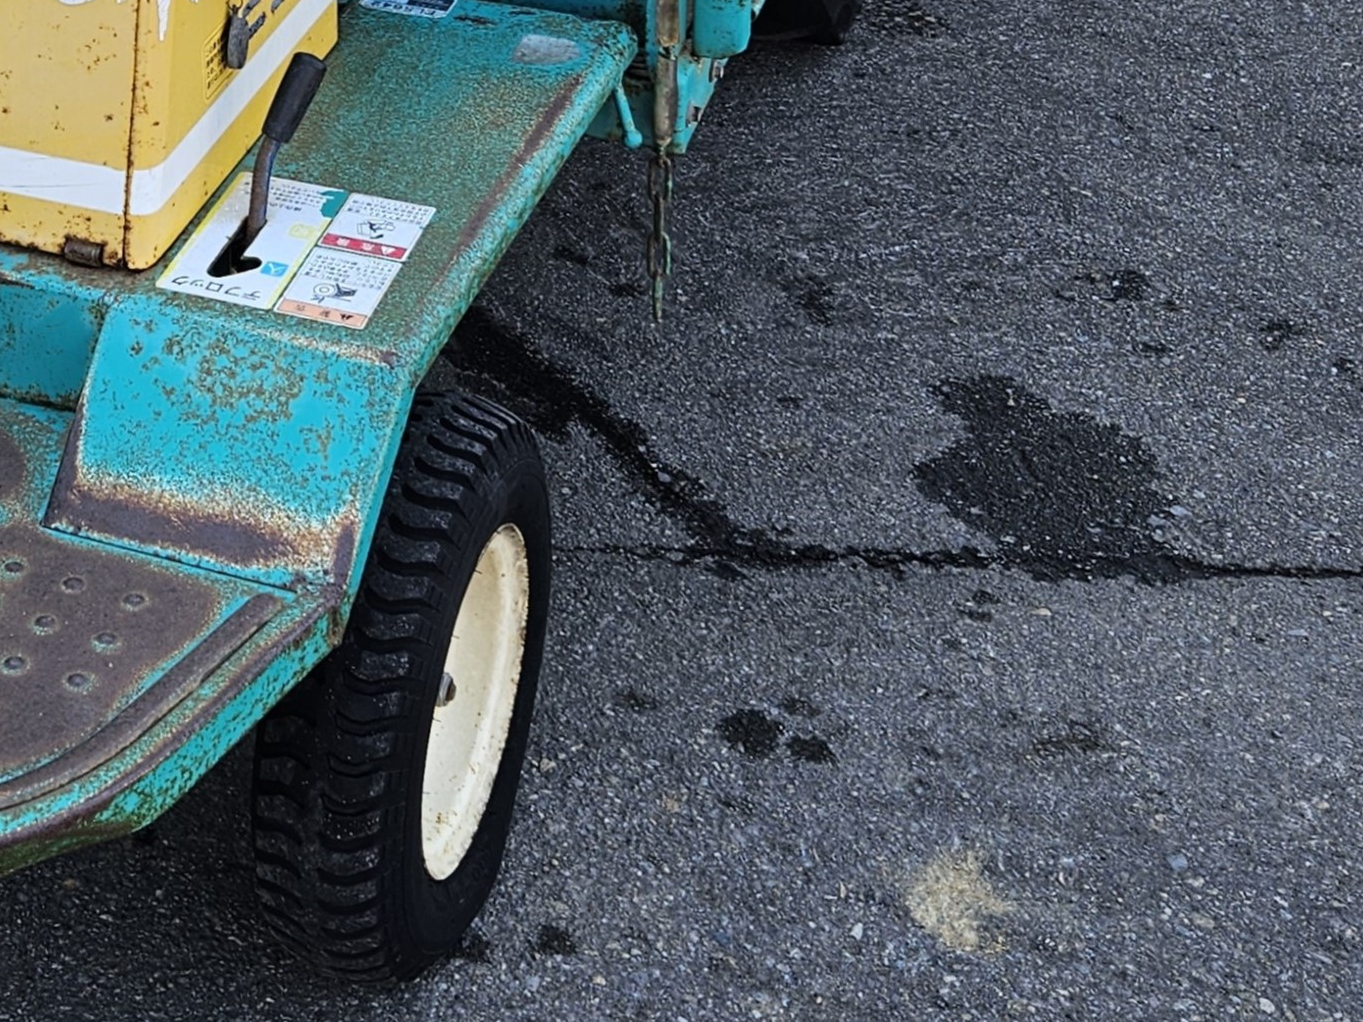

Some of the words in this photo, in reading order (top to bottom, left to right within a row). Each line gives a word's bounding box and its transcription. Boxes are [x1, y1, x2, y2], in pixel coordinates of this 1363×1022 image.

[172, 275, 261, 301] デフロック
